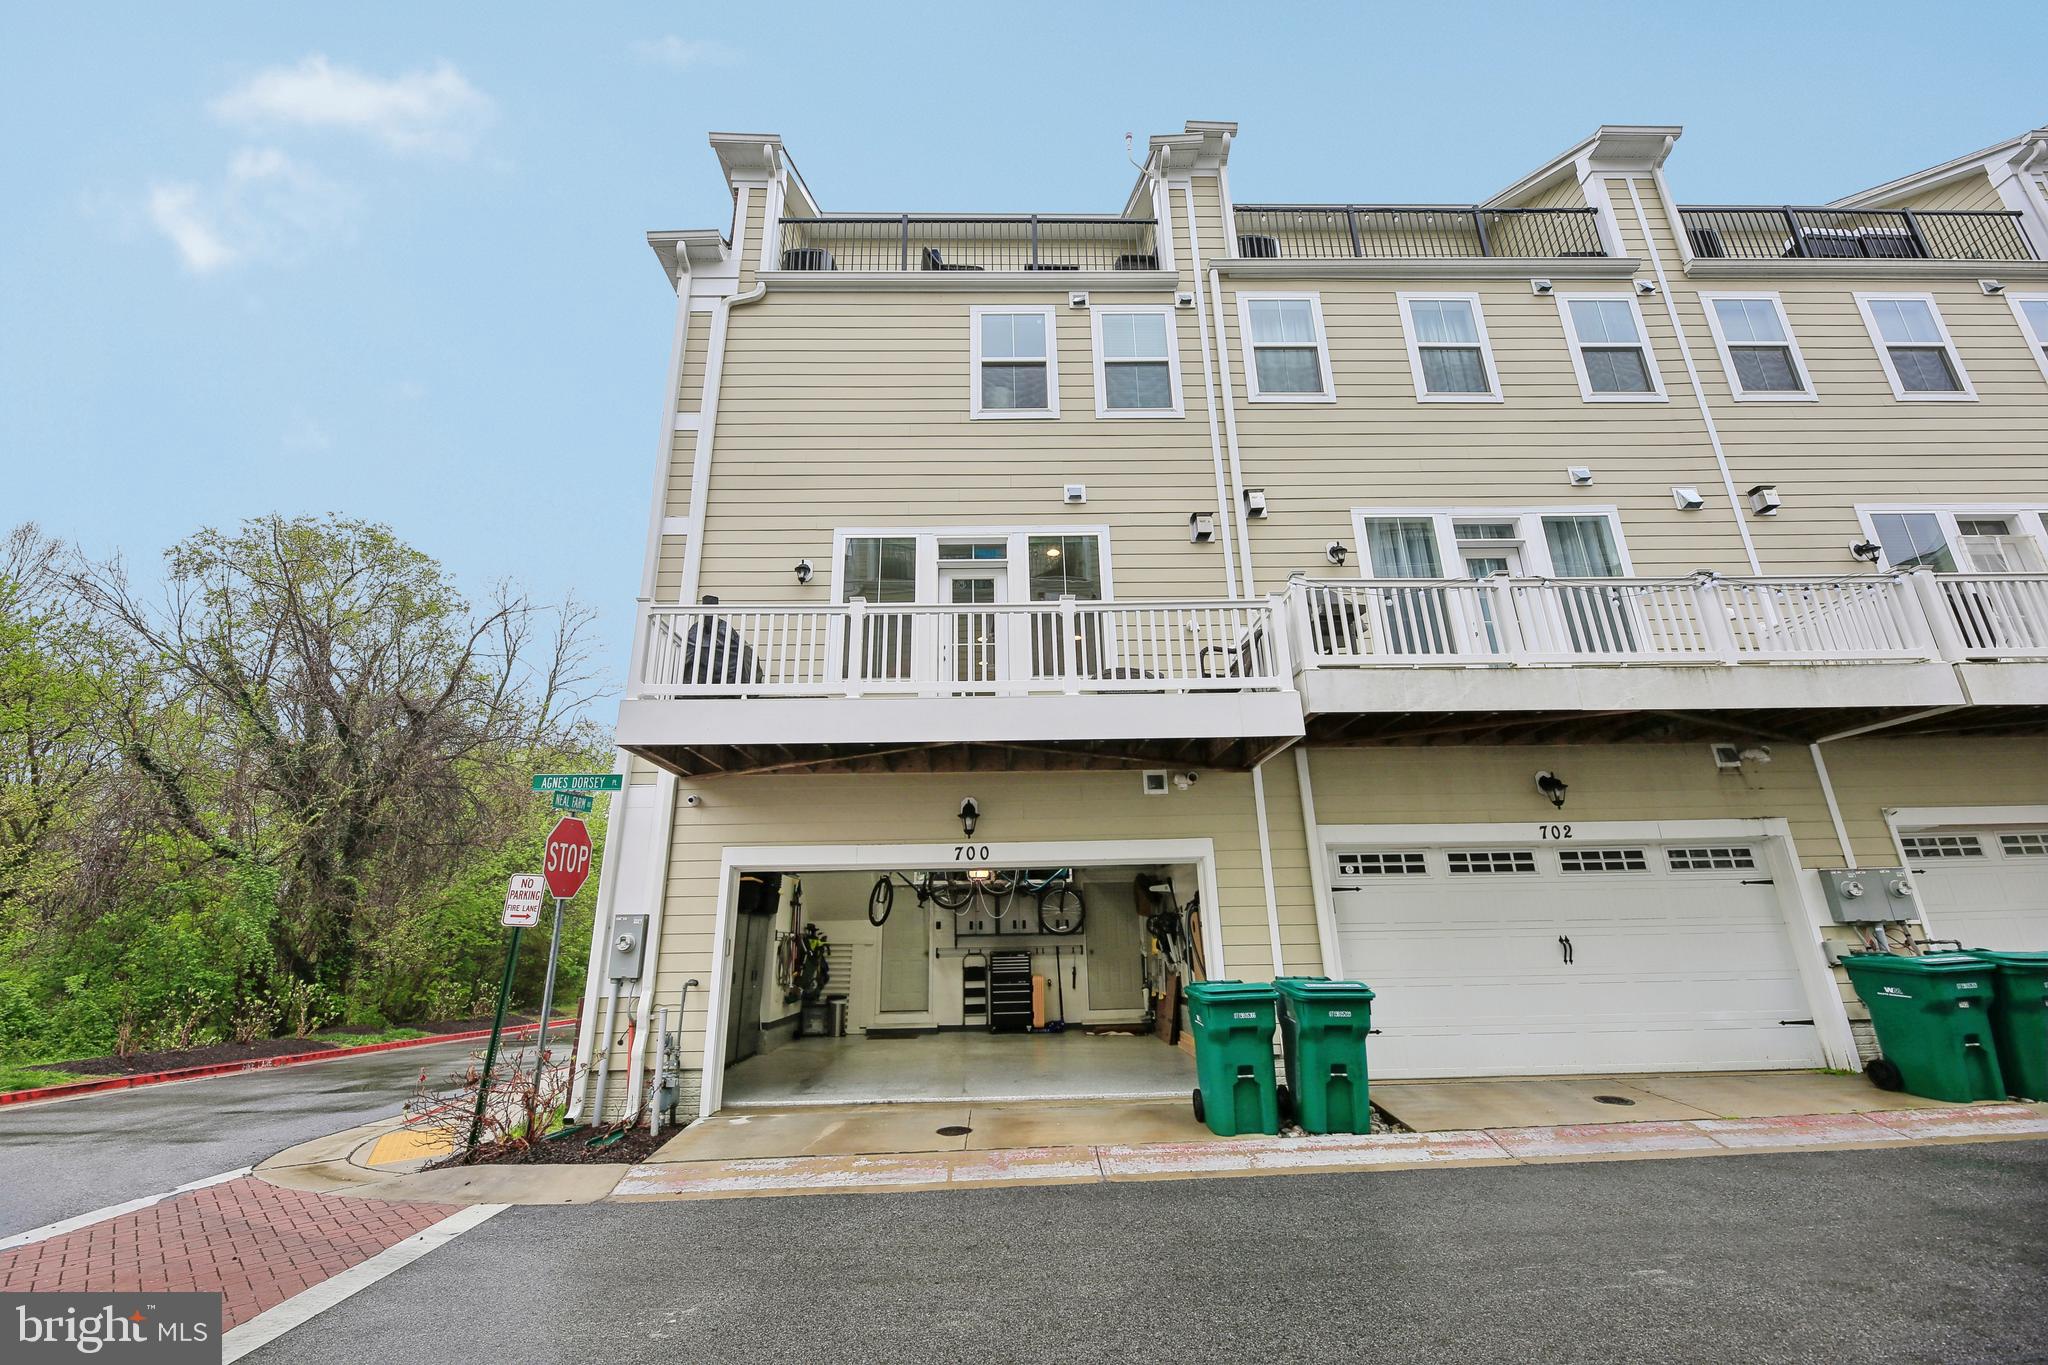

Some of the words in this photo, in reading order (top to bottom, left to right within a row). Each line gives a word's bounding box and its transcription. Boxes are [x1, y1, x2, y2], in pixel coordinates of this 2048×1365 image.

[541, 777, 568, 788] AGNES
[571, 777, 605, 788] DORSEY
[555, 793, 570, 807] NEAL
[571, 795, 586, 809] FARM
[1539, 825, 1572, 839] 702
[547, 841, 589, 873] STOP
[954, 846, 989, 861] 700
[520, 878, 534, 889] NO
[509, 890, 541, 901] PARKING
